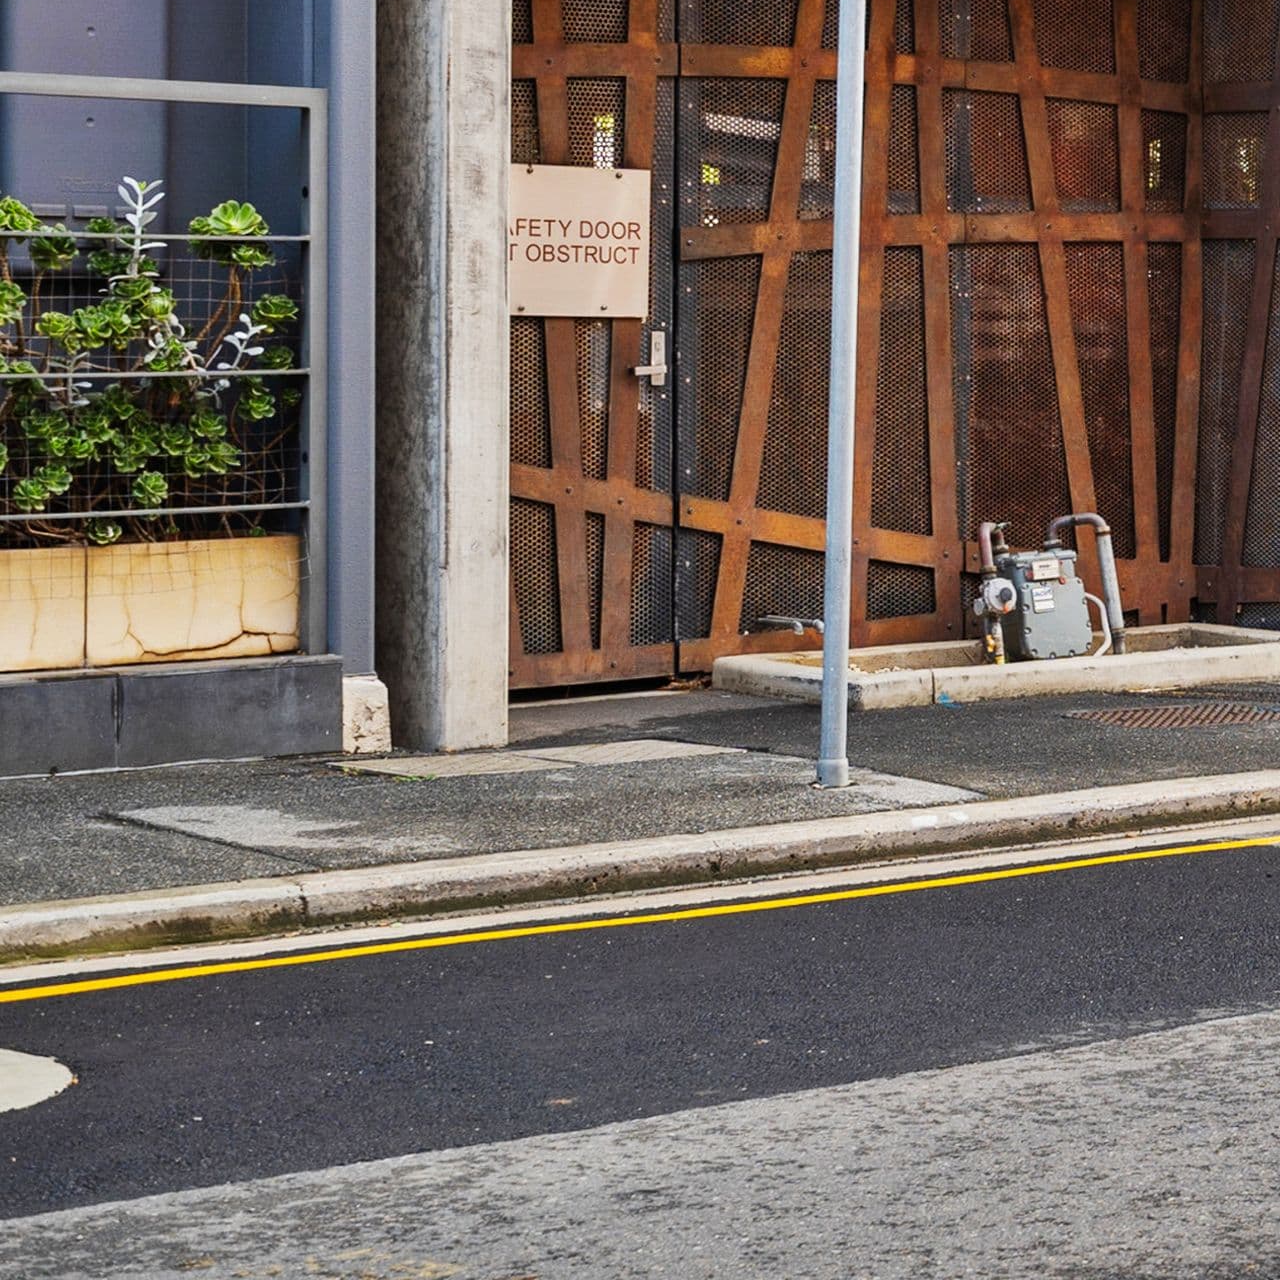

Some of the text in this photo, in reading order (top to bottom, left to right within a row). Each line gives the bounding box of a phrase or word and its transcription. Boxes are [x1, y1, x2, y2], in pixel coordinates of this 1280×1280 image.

[510, 218, 641, 240] FETY DOOR
[525, 243, 641, 264] OBSTRUCT
